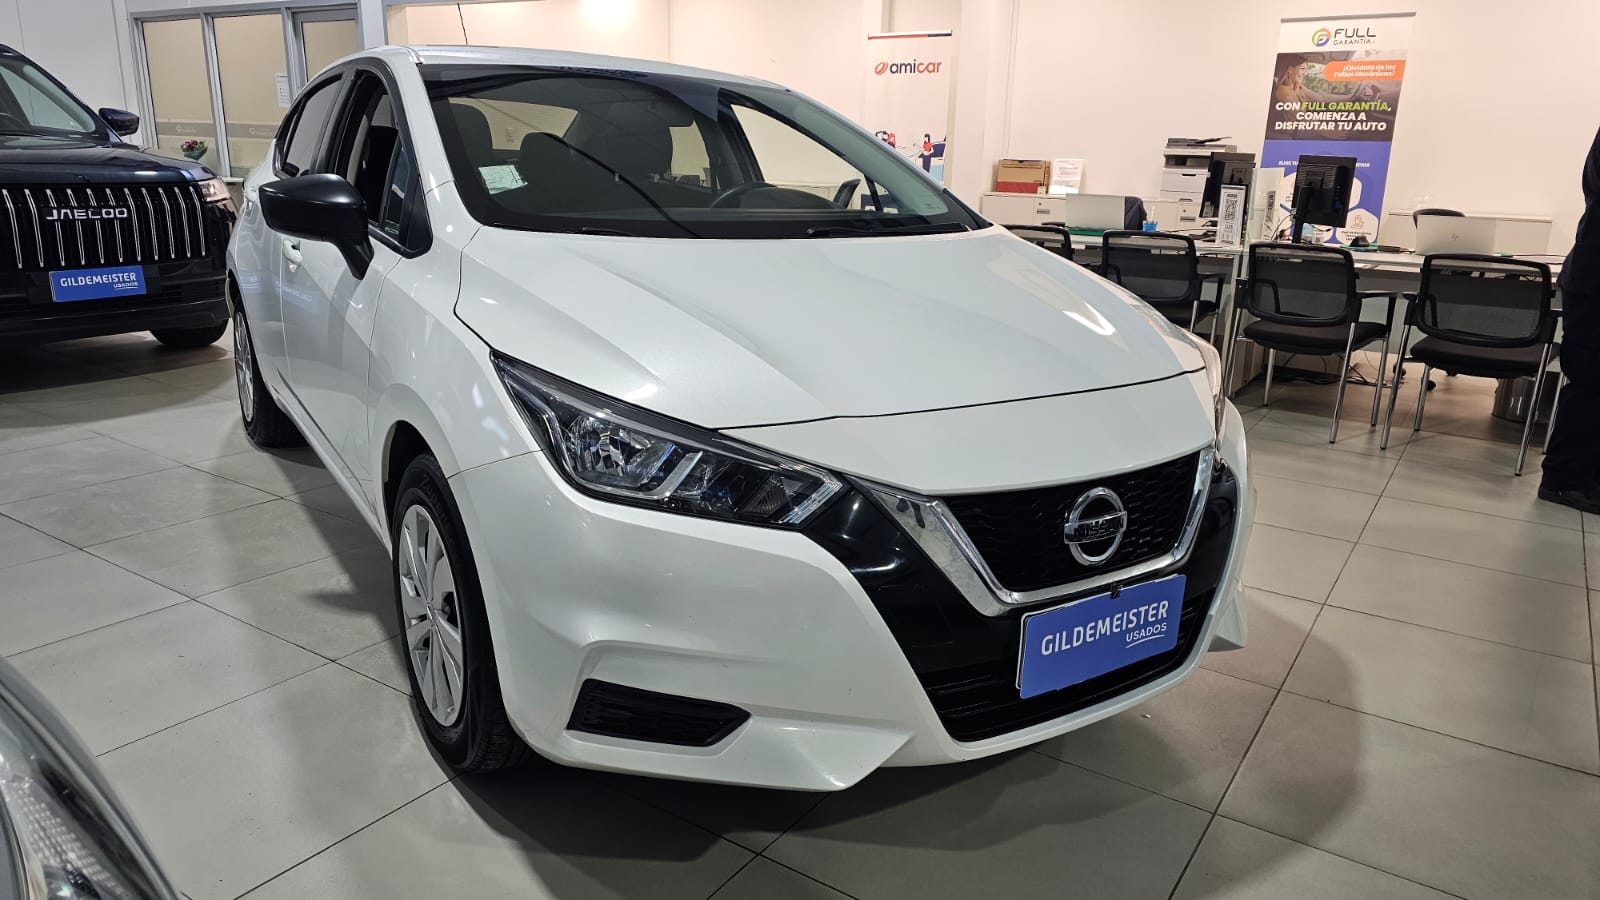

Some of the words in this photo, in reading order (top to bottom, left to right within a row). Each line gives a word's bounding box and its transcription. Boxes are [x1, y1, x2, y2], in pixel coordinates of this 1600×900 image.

[1333, 27, 1377, 38] FULL
[889, 58, 942, 74] amicar
[1275, 102, 1300, 111] CON
[1301, 101, 1327, 111] FULL
[1296, 111, 1356, 121] COMIENZA
[1357, 111, 1367, 120] A
[1274, 121, 1335, 130] DISFRUTAR
[1337, 121, 1354, 130] TU
[1354, 121, 1387, 131] AUTO
[60, 272, 137, 287] GILDEMEISTER
[1041, 600, 1169, 656] GILDEMEISTER
[1125, 622, 1167, 643] USADOS
